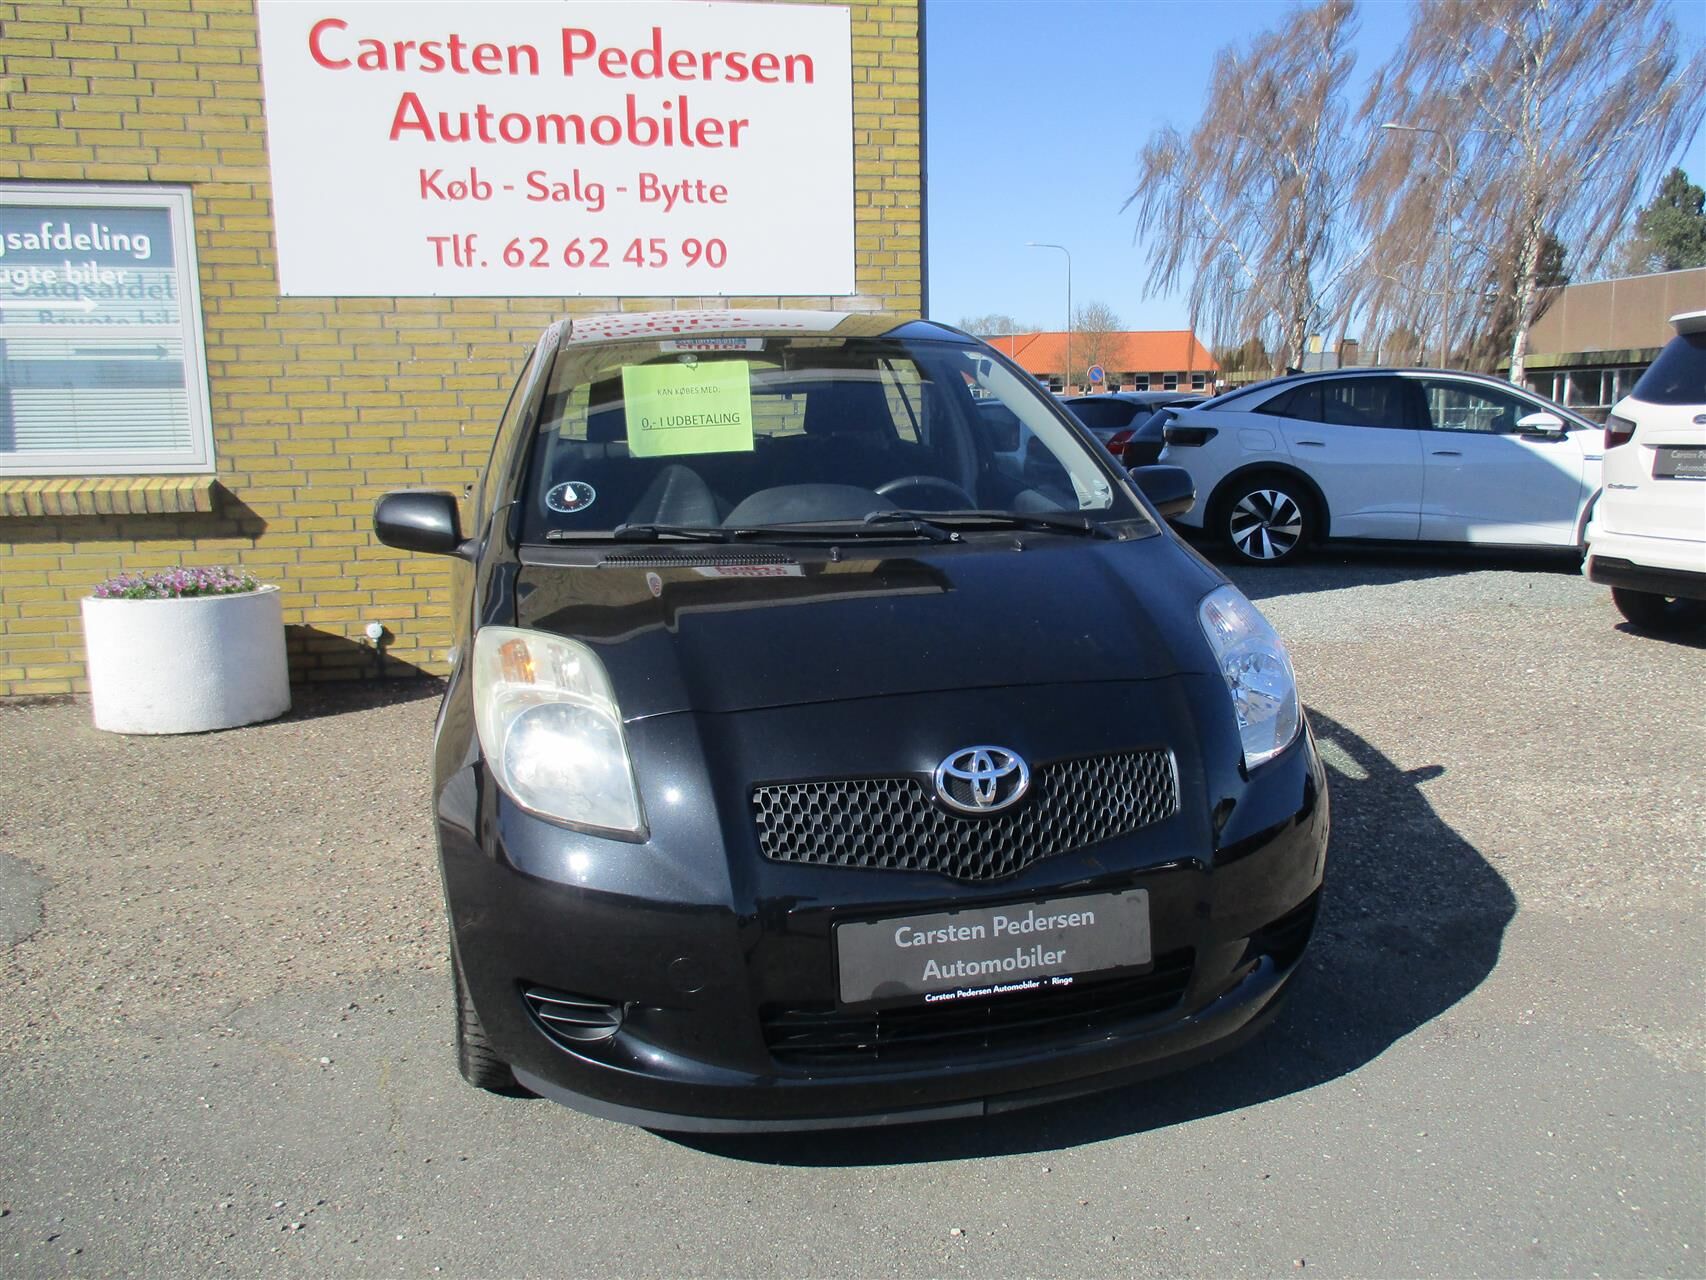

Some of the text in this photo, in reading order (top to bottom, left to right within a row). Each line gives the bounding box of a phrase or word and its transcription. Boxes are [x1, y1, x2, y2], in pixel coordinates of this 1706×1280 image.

[308, 17, 816, 85] Carsten Pedersen
[389, 91, 750, 149] Automobiler
[418, 166, 494, 202] Køb
[525, 168, 606, 213] Salg
[638, 171, 729, 213] Bytte
[0, 221, 151, 260] safdeling
[427, 233, 729, 269] Tlf. 62 62 45 90
[64, 260, 128, 286] biler
[657, 388, 673, 396] KAN
[675, 386, 699, 395] KØBES
[666, 412, 740, 427] UDBETALING
[895, 909, 1096, 948] Carsten Pedersen
[922, 944, 1067, 981] Automobiler
[924, 976, 1074, 1002] Carsten Pedersen Automobiler Ringe
